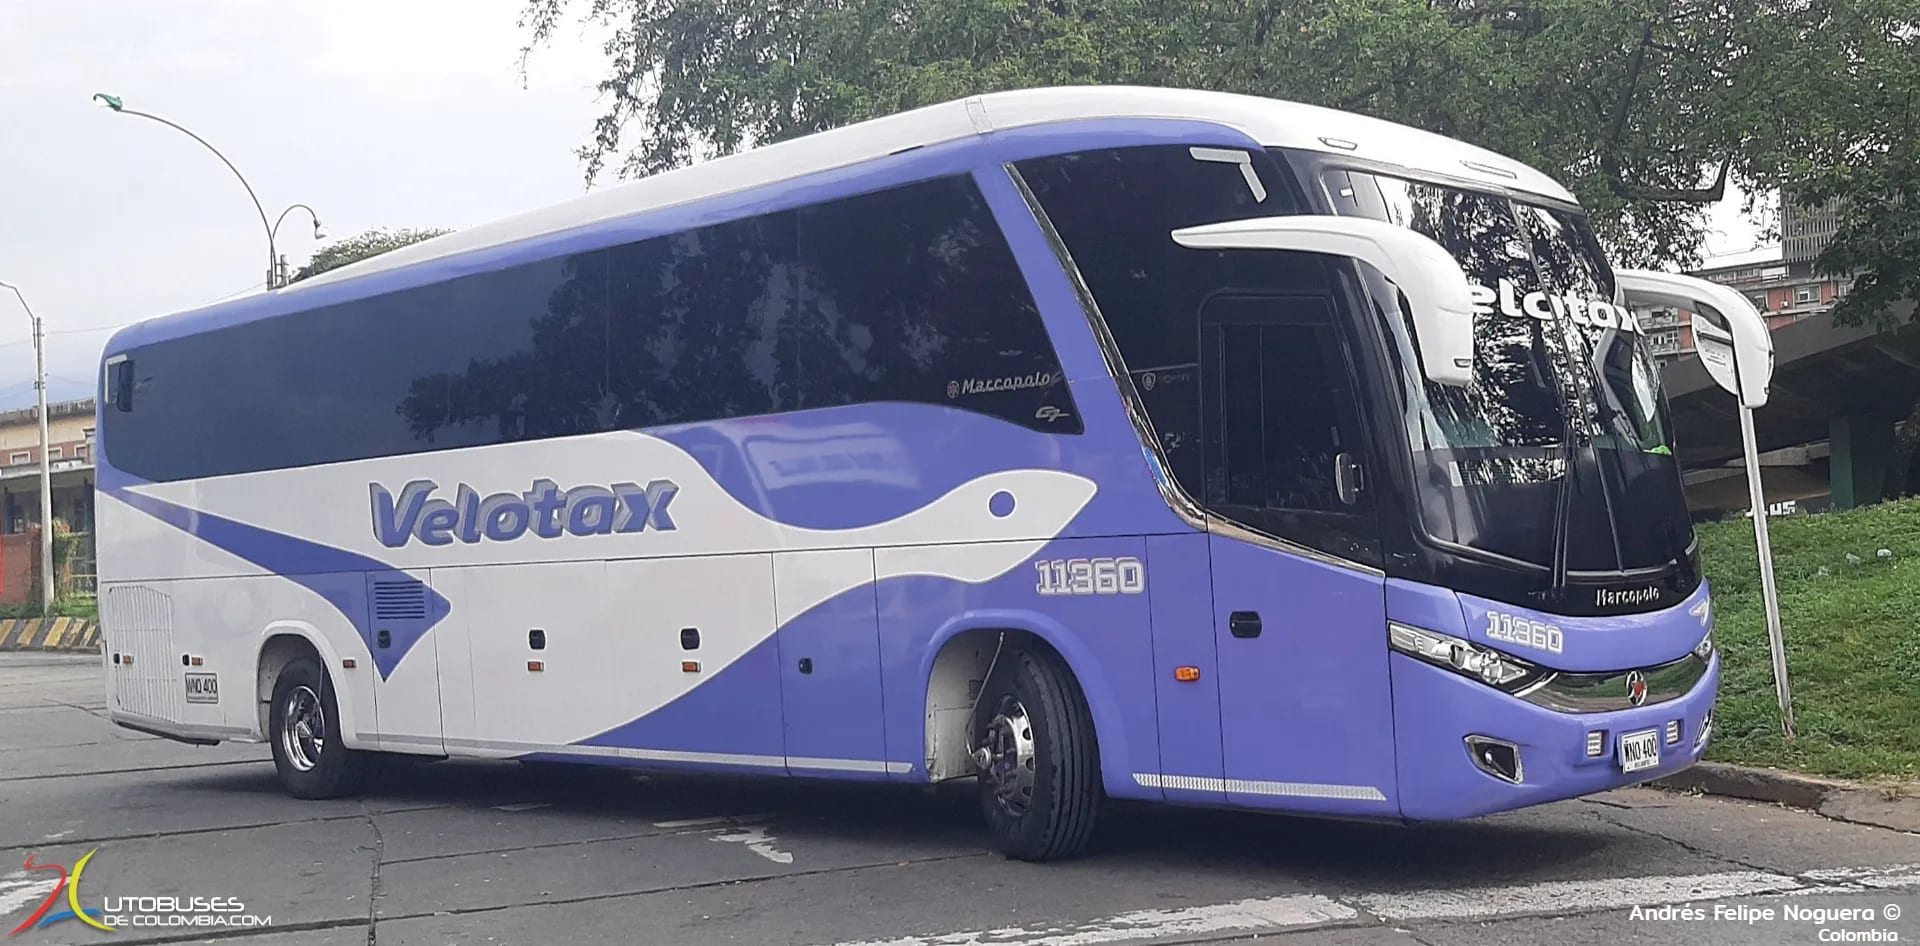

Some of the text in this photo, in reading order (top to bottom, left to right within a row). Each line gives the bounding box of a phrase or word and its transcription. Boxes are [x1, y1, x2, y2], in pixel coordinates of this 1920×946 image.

[1468, 277, 1644, 336] elotax
[962, 371, 1050, 395] Marcopolo
[369, 479, 680, 548] Velotax
[1035, 556, 1145, 594] 11360
[1595, 586, 1660, 607] Marcopolo
[1486, 610, 1564, 655] 11360
[1643, 737, 1657, 759] 400
